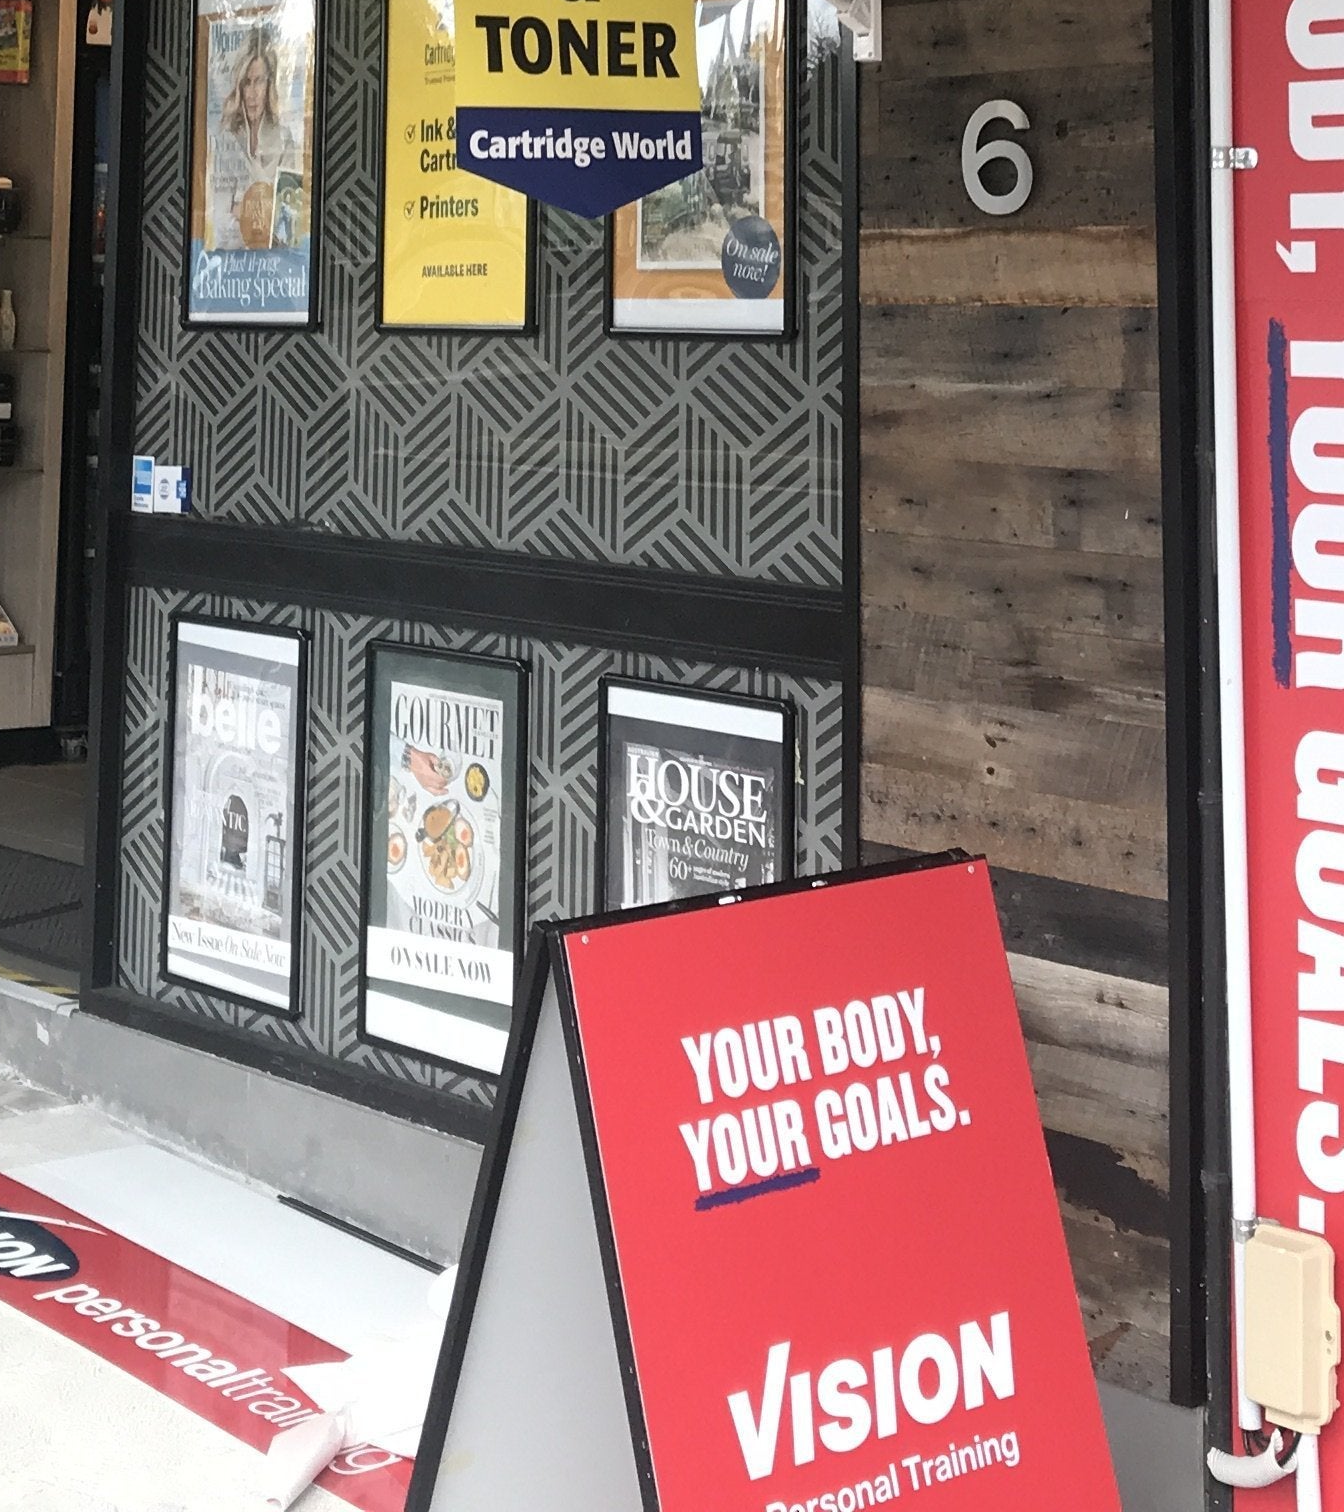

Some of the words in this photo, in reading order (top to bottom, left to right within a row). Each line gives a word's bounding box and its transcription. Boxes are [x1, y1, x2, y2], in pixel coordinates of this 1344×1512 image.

[475, 14, 680, 79] TONER
[420, 118, 443, 144] Ink
[468, 127, 606, 167] Cartridge
[612, 128, 693, 162] World
[961, 99, 1034, 215] 6
[419, 195, 479, 220] Printers
[421, 264, 464, 279] AVAILABLE
[466, 262, 488, 278] HERE
[726, 236, 748, 260] On
[750, 240, 779, 266] sale
[732, 261, 768, 283] now!
[199, 265, 252, 307] Baking
[253, 265, 306, 307] special
[191, 678, 282, 755] belle
[395, 693, 500, 760] GOURMET
[626, 753, 767, 823] HOUSE
[630, 778, 667, 828] &
[665, 806, 766, 849] GARDEN
[645, 827, 680, 853] Town
[682, 835, 693, 857] &
[694, 838, 750, 872] Country
[409, 915, 476, 946] CLASSICS
[412, 895, 474, 929] MODERN
[172, 922, 193, 945] New
[197, 926, 223, 952] Issue
[224, 934, 238, 955] On
[240, 939, 262, 961] Sale
[263, 943, 286, 968] Now
[391, 945, 413, 969] ON
[414, 948, 454, 977] SALE
[456, 956, 492, 985] NOW
[680, 1015, 812, 1104] YOUR
[813, 987, 942, 1077] BODY,
[679, 1099, 812, 1192] YOUR
[815, 1064, 971, 1160] GOALS.
[726, 1311, 1017, 1481] VISION
[902, 1431, 1022, 1492] Training
